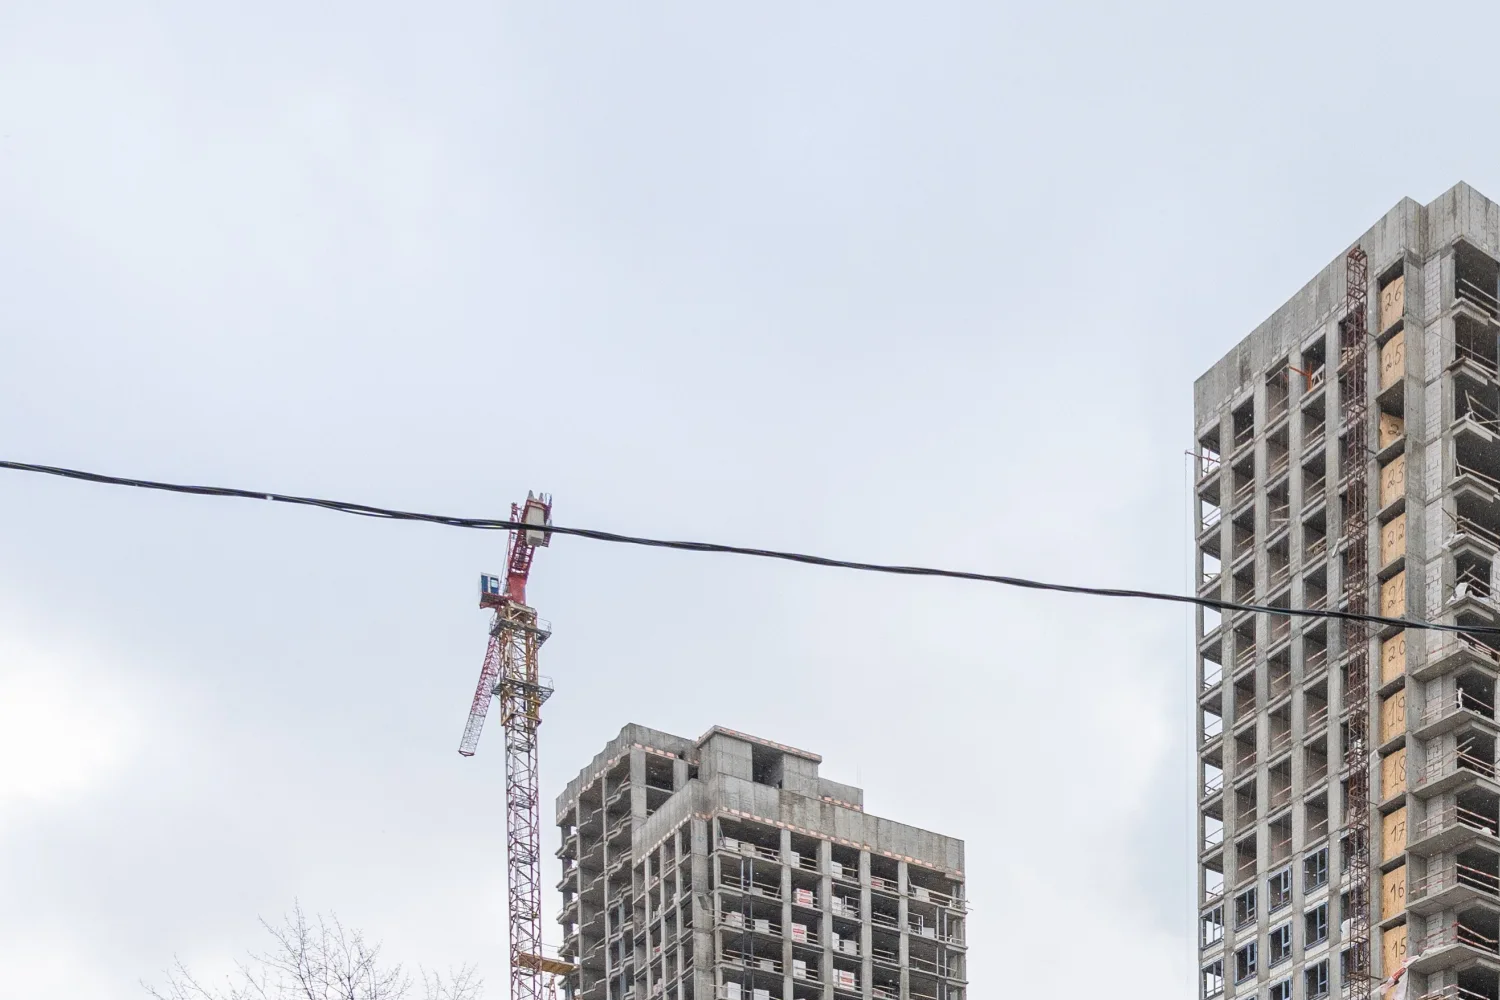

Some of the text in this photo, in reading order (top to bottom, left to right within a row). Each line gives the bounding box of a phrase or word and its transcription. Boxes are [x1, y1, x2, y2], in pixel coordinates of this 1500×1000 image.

[1385, 281, 1404, 312] 26
[1385, 341, 1404, 371] 25
[1387, 461, 1405, 488] 23
[1388, 523, 1404, 547] 22
[1388, 579, 1404, 608] 21
[1388, 640, 1405, 662] 20
[1389, 696, 1405, 727] 19
[1390, 755, 1406, 788] 18
[1391, 821, 1405, 842] 17
[1390, 880, 1405, 902] 16
[1392, 937, 1406, 957] 15
